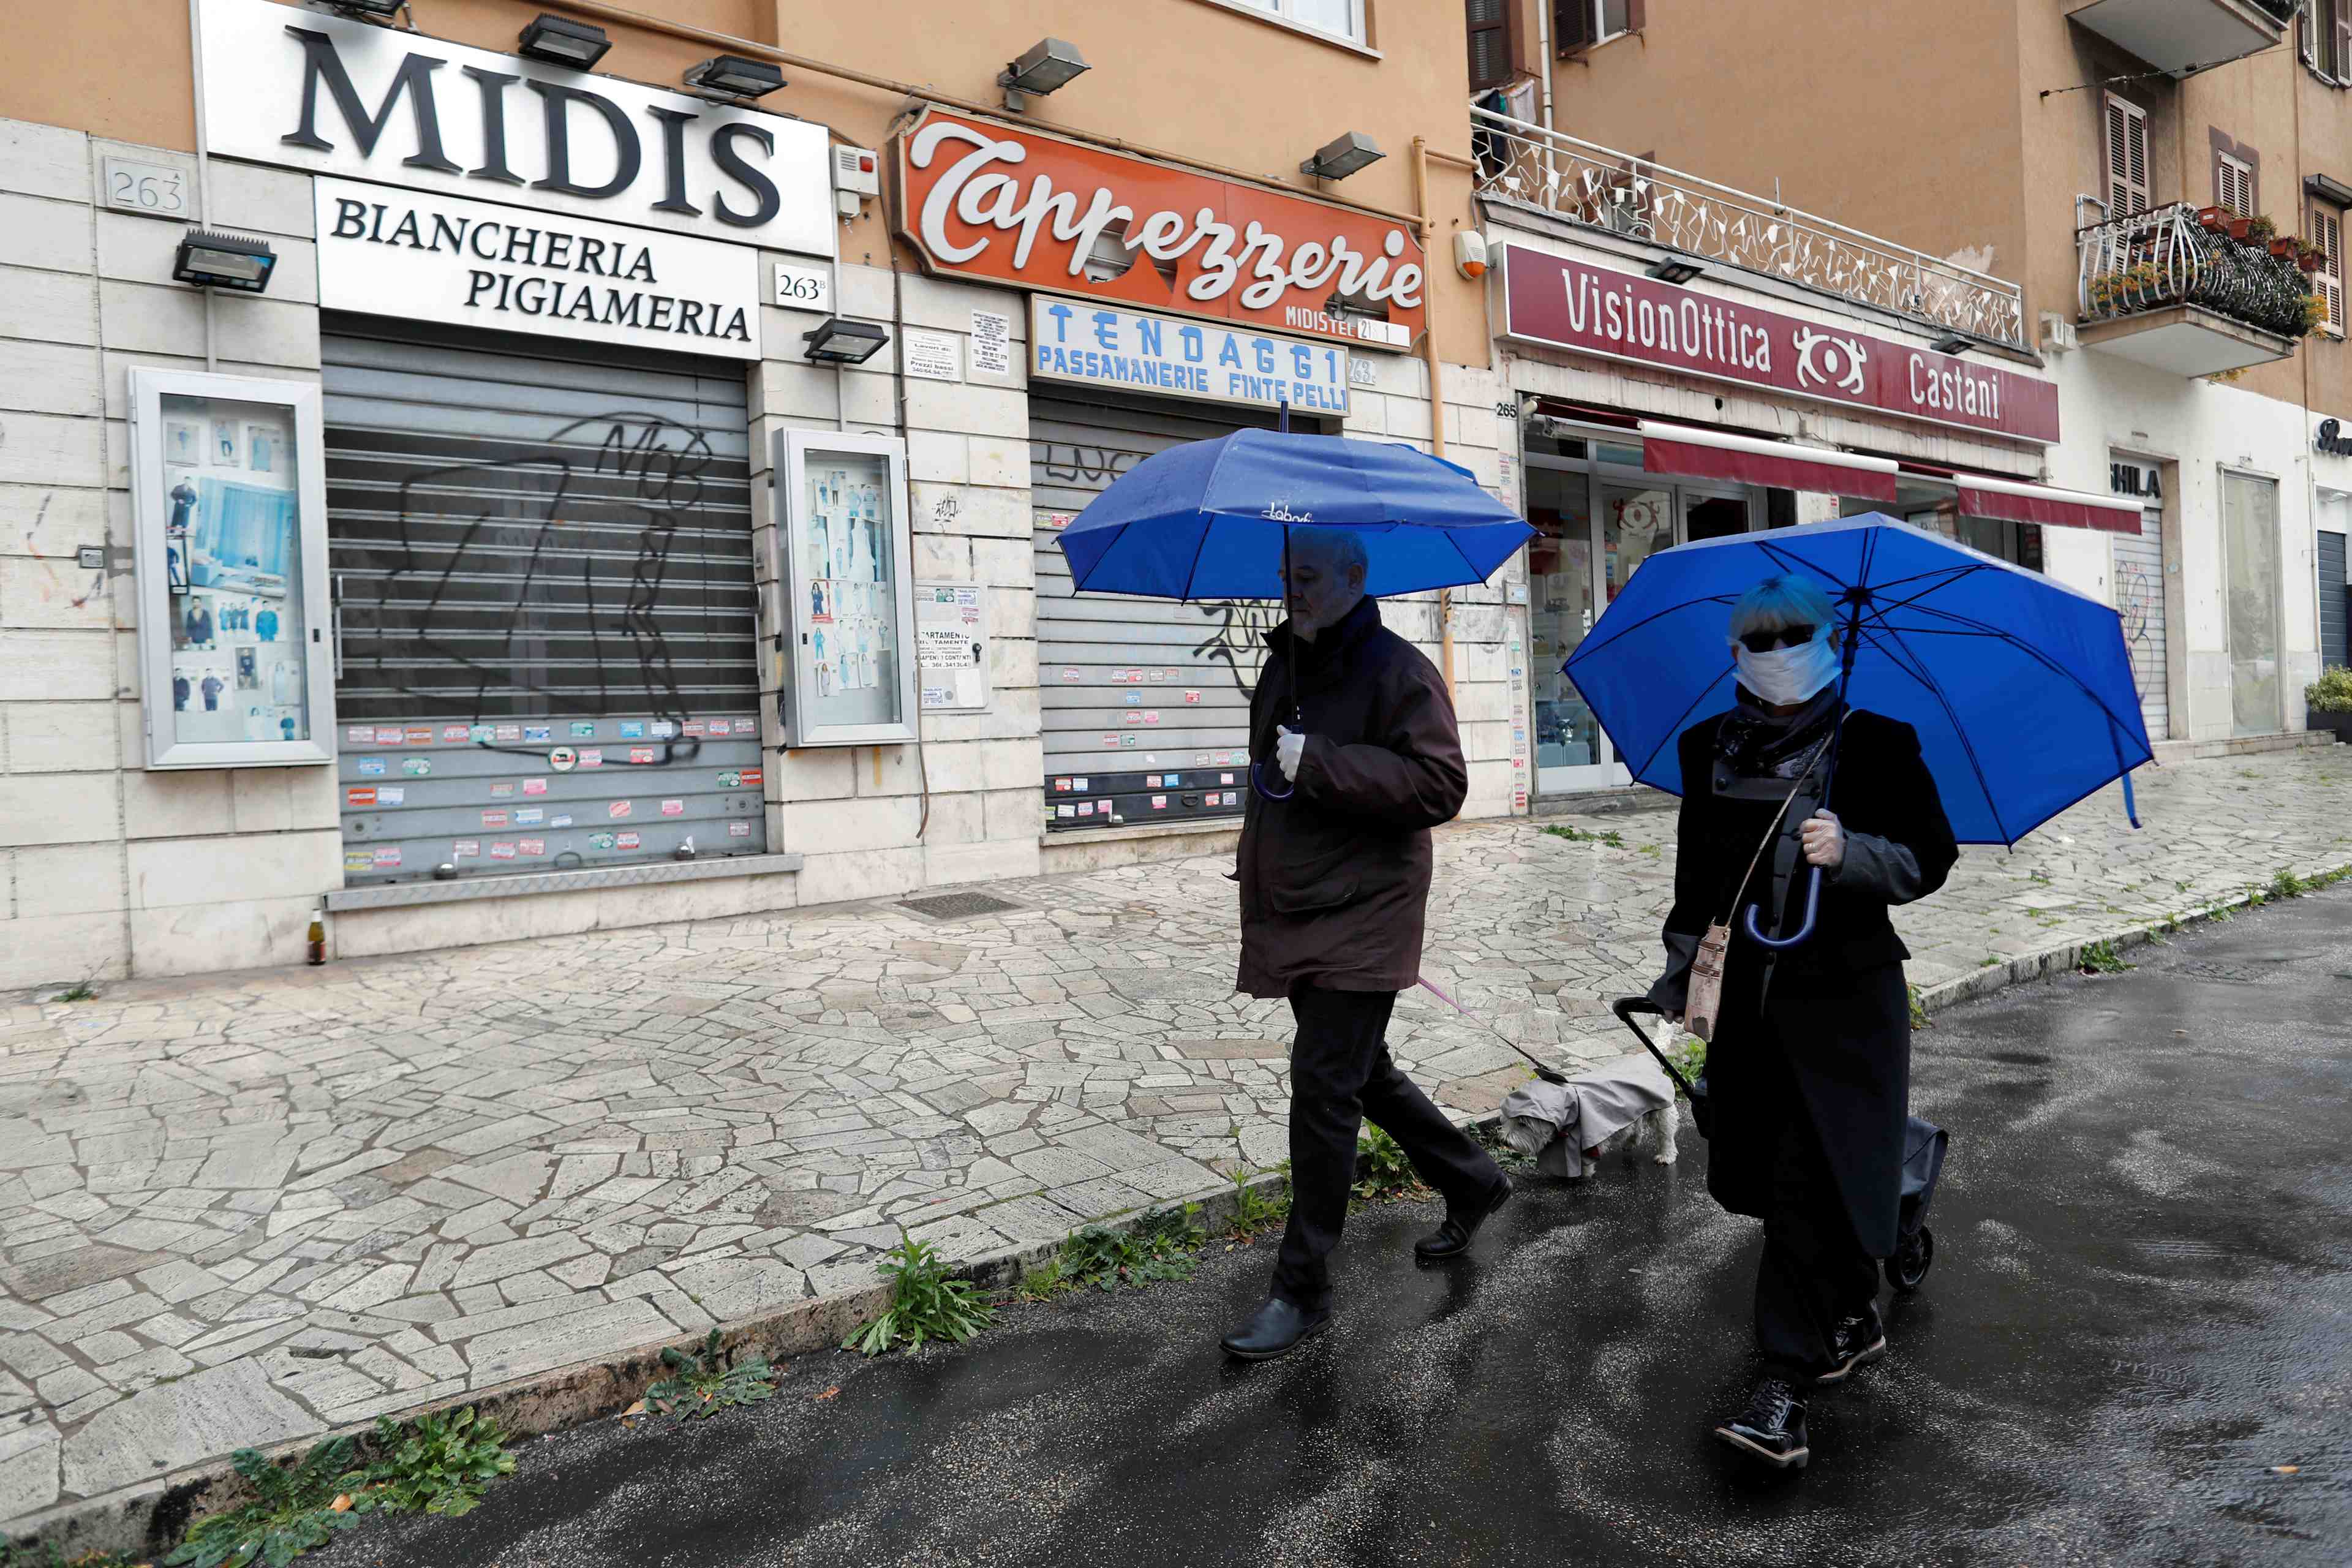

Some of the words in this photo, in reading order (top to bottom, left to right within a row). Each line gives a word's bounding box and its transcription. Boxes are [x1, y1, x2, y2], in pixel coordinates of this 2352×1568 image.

[281, 24, 781, 227] MIDIS
[331, 198, 657, 284] BIANCHERIA
[910, 122, 1422, 309] Tappezzerie
[464, 270, 753, 342] PIGIAMERIA
[1038, 345, 1208, 392] PASSAMANERIE
[1230, 373, 1288, 402] FINTE
[1294, 382, 1347, 411] PELLI
[1049, 304, 1336, 383] TENDAGGI
[1496, 402, 1517, 418] 265
[1909, 353, 1999, 420] Castani
[2109, 462, 2162, 499] HILA
